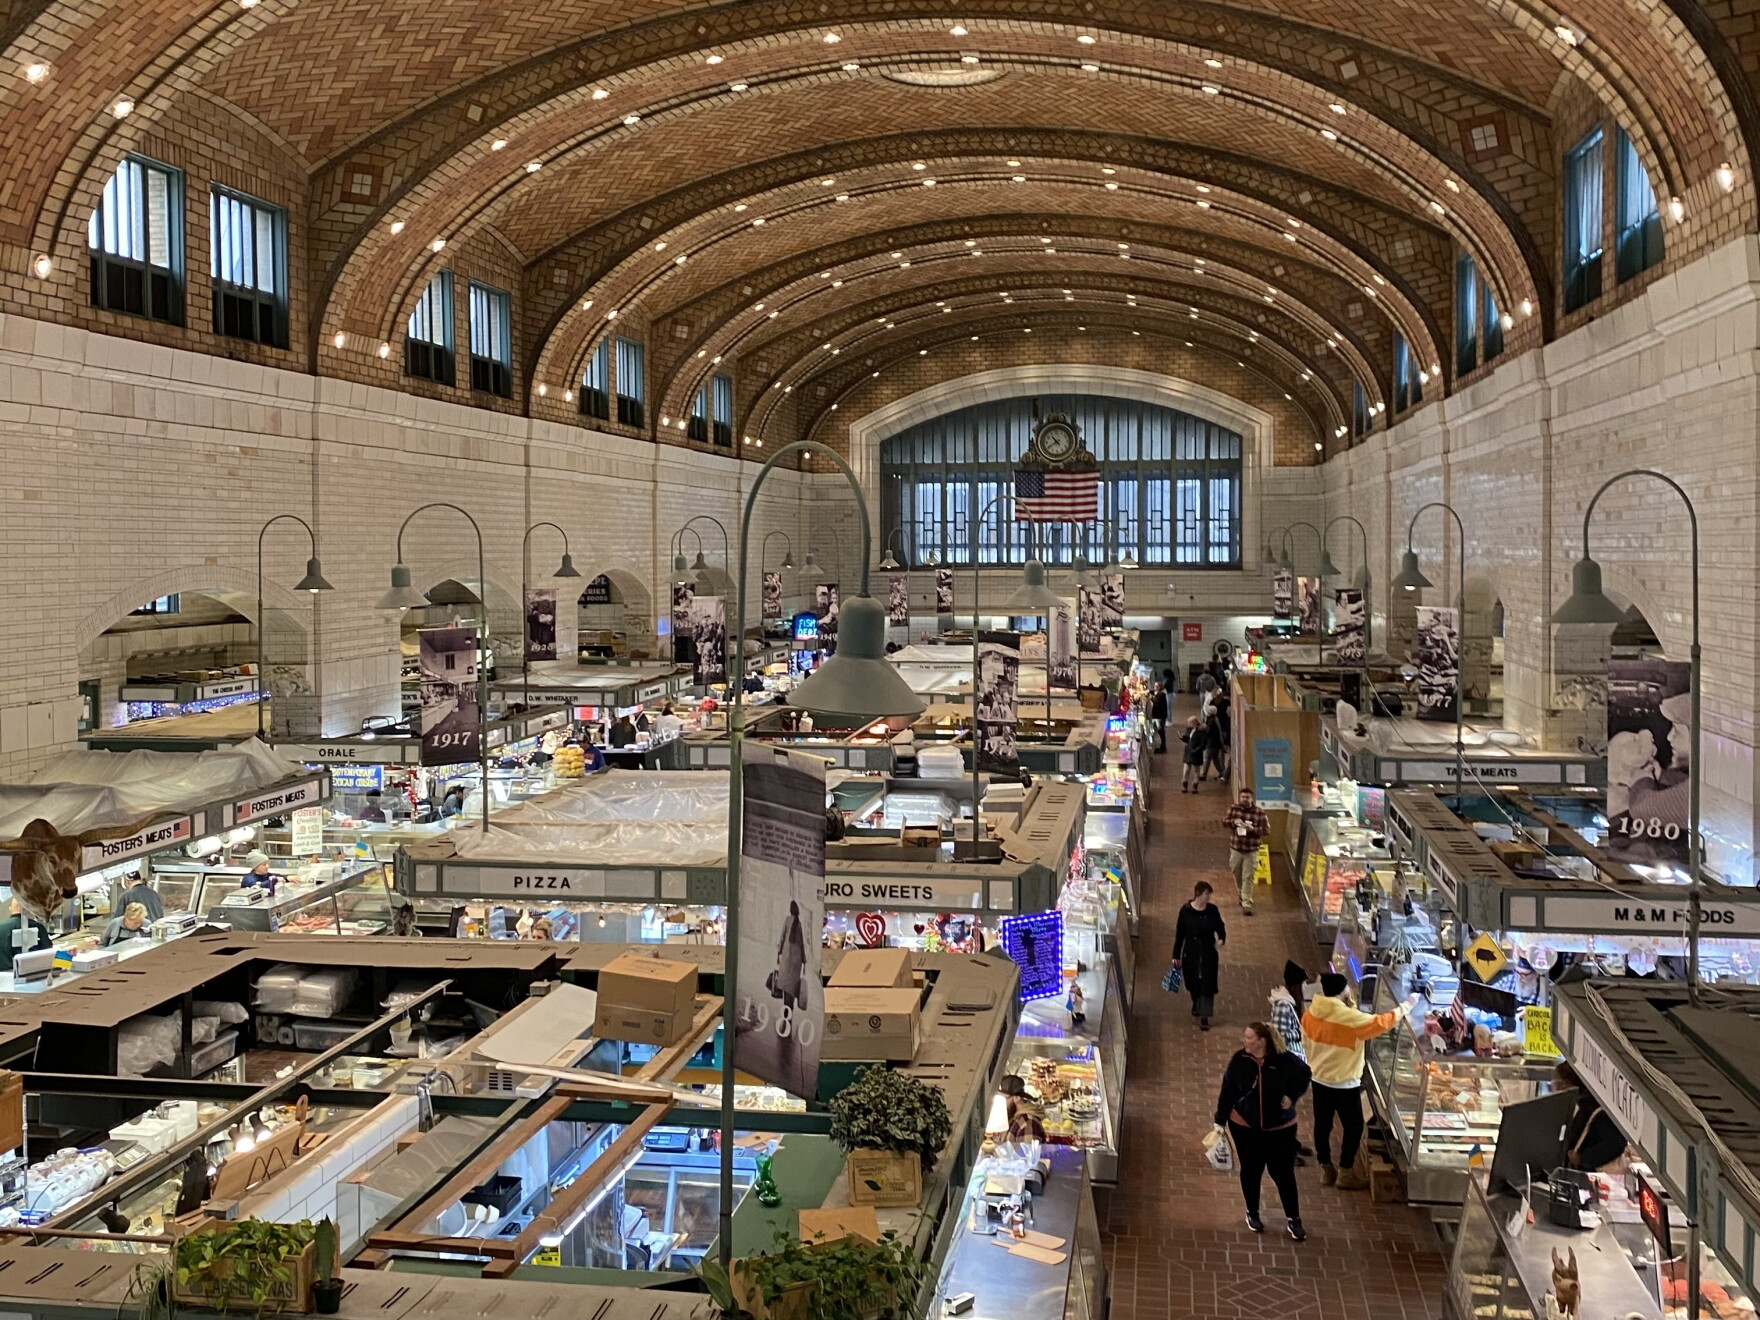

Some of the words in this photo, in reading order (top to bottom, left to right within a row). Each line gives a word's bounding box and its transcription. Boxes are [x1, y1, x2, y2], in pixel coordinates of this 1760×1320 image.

[432, 730, 472, 748] 1917
[318, 748, 356, 758] ORALE
[1445, 767, 1478, 777] TASE
[1480, 767, 1518, 778] MEATS
[252, 796, 283, 813] FOSTER'S
[285, 789, 306, 804] MEATS
[1617, 816, 1680, 840] 1980
[102, 833, 143, 858] FOSTER'S
[146, 827, 172, 844] MEATS
[514, 876, 571, 889] PIZZA
[861, 884, 933, 900] SWEETS
[1614, 907, 1629, 921] M
[1634, 908, 1646, 921] &
[1651, 908, 1666, 922] M
[740, 995, 816, 1046] 1980
[1527, 1020, 1552, 1032] BAC
[1540, 1033, 1547, 1041] IS
[1611, 1067, 1640, 1131] MEATS
